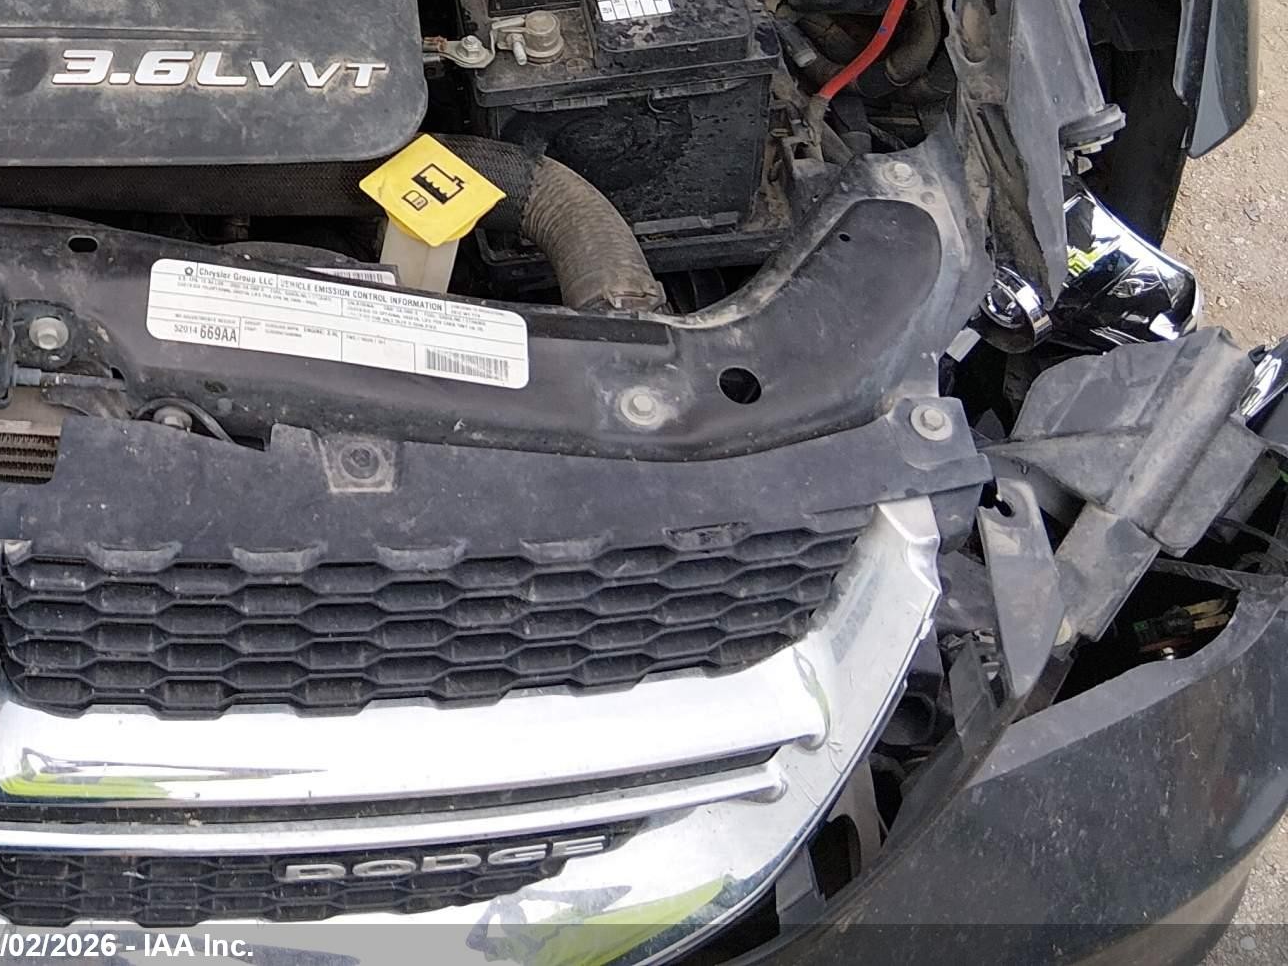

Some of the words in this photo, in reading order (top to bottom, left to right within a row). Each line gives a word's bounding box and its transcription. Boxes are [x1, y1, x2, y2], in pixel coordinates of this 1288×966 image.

[51, 49, 248, 87] 3.6L
[250, 60, 387, 89] VVT
[199, 267, 231, 281] Chrysler
[233, 272, 257, 285] Group
[258, 276, 274, 286] LLC
[280, 279, 312, 291] VEHICLE
[314, 284, 351, 297] EMISSION
[352, 290, 388, 304] CONTROL
[389, 295, 443, 311] INFORMATION
[173, 324, 198, 334] 52014
[200, 325, 237, 343] 669AA
[285, 835, 607, 882] DODGE
